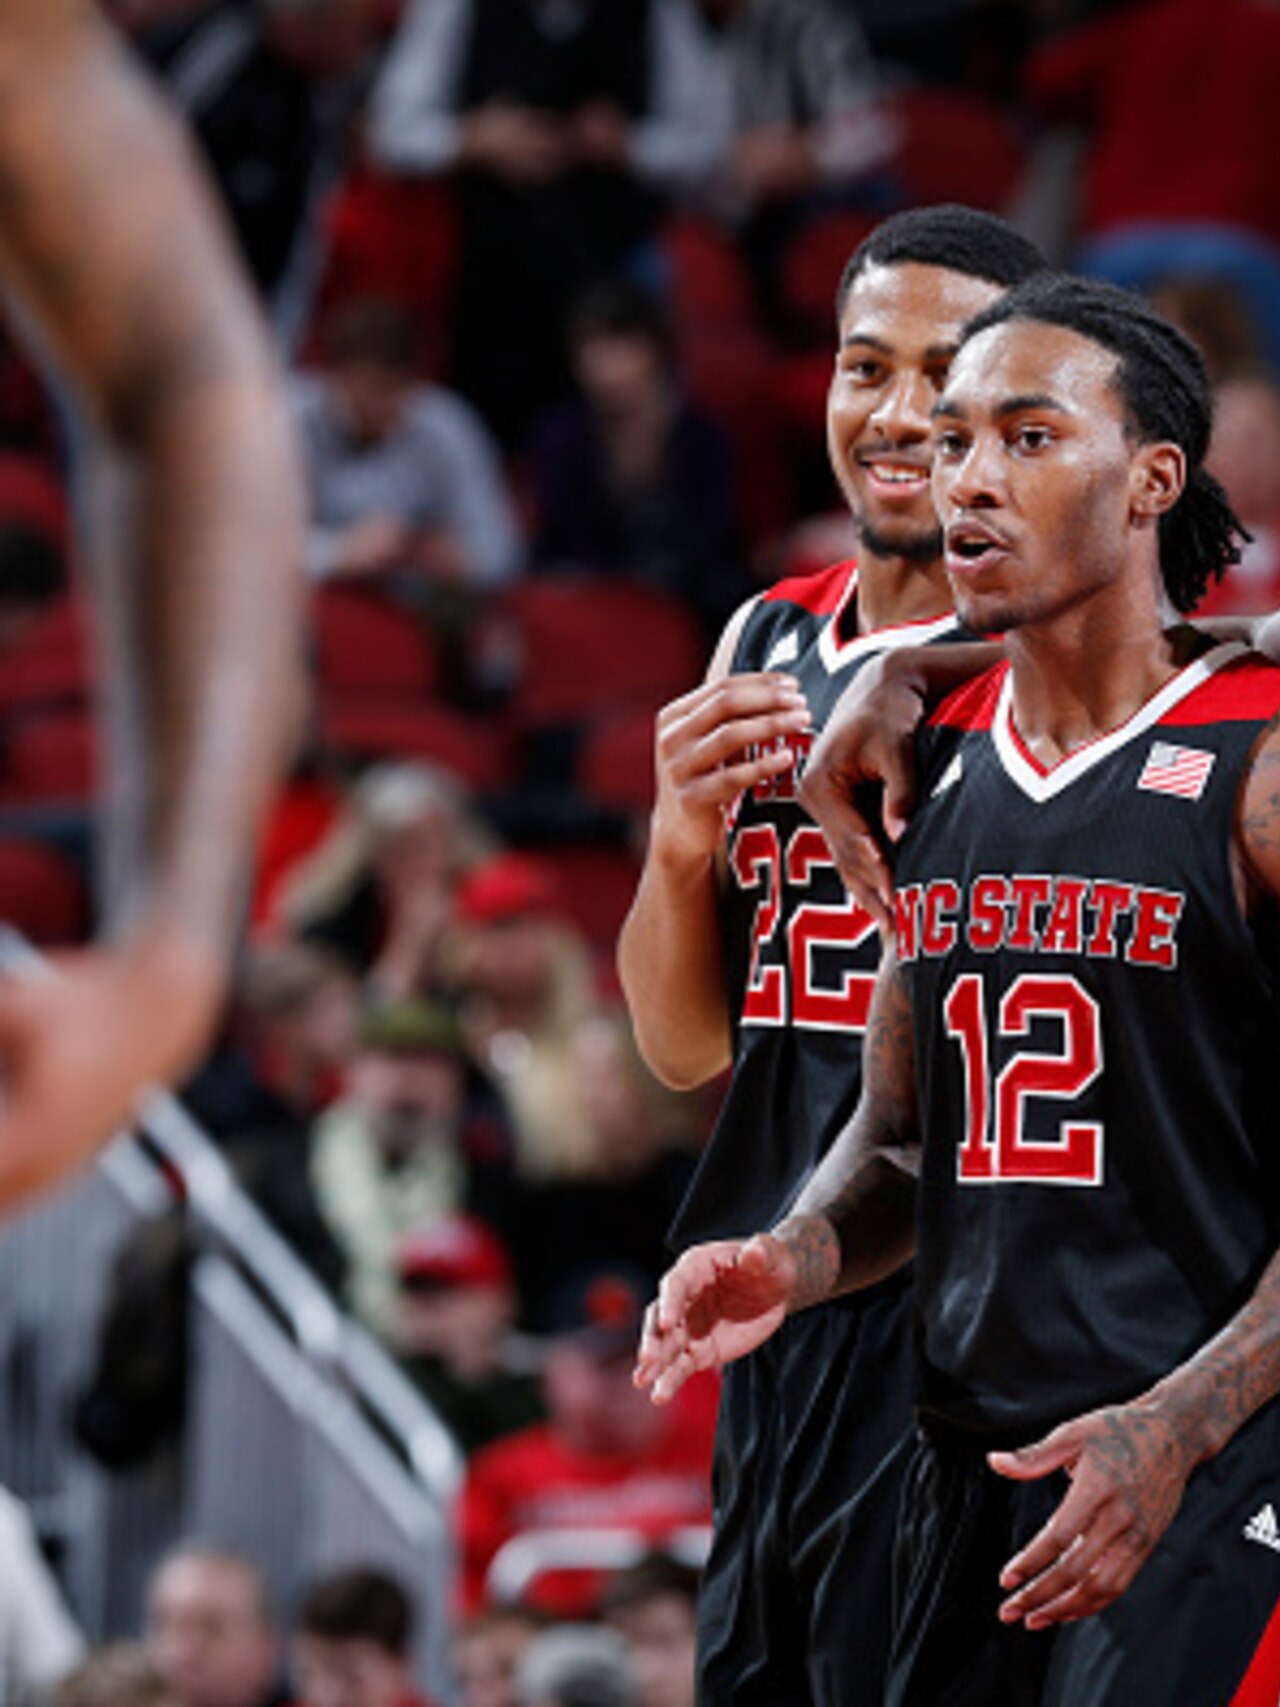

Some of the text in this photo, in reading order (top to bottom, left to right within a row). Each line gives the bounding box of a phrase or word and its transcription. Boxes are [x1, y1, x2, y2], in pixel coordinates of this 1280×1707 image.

[732, 823, 880, 1033] 22
[893, 873, 1185, 969] NC STATE
[944, 972, 1104, 1187] 12
